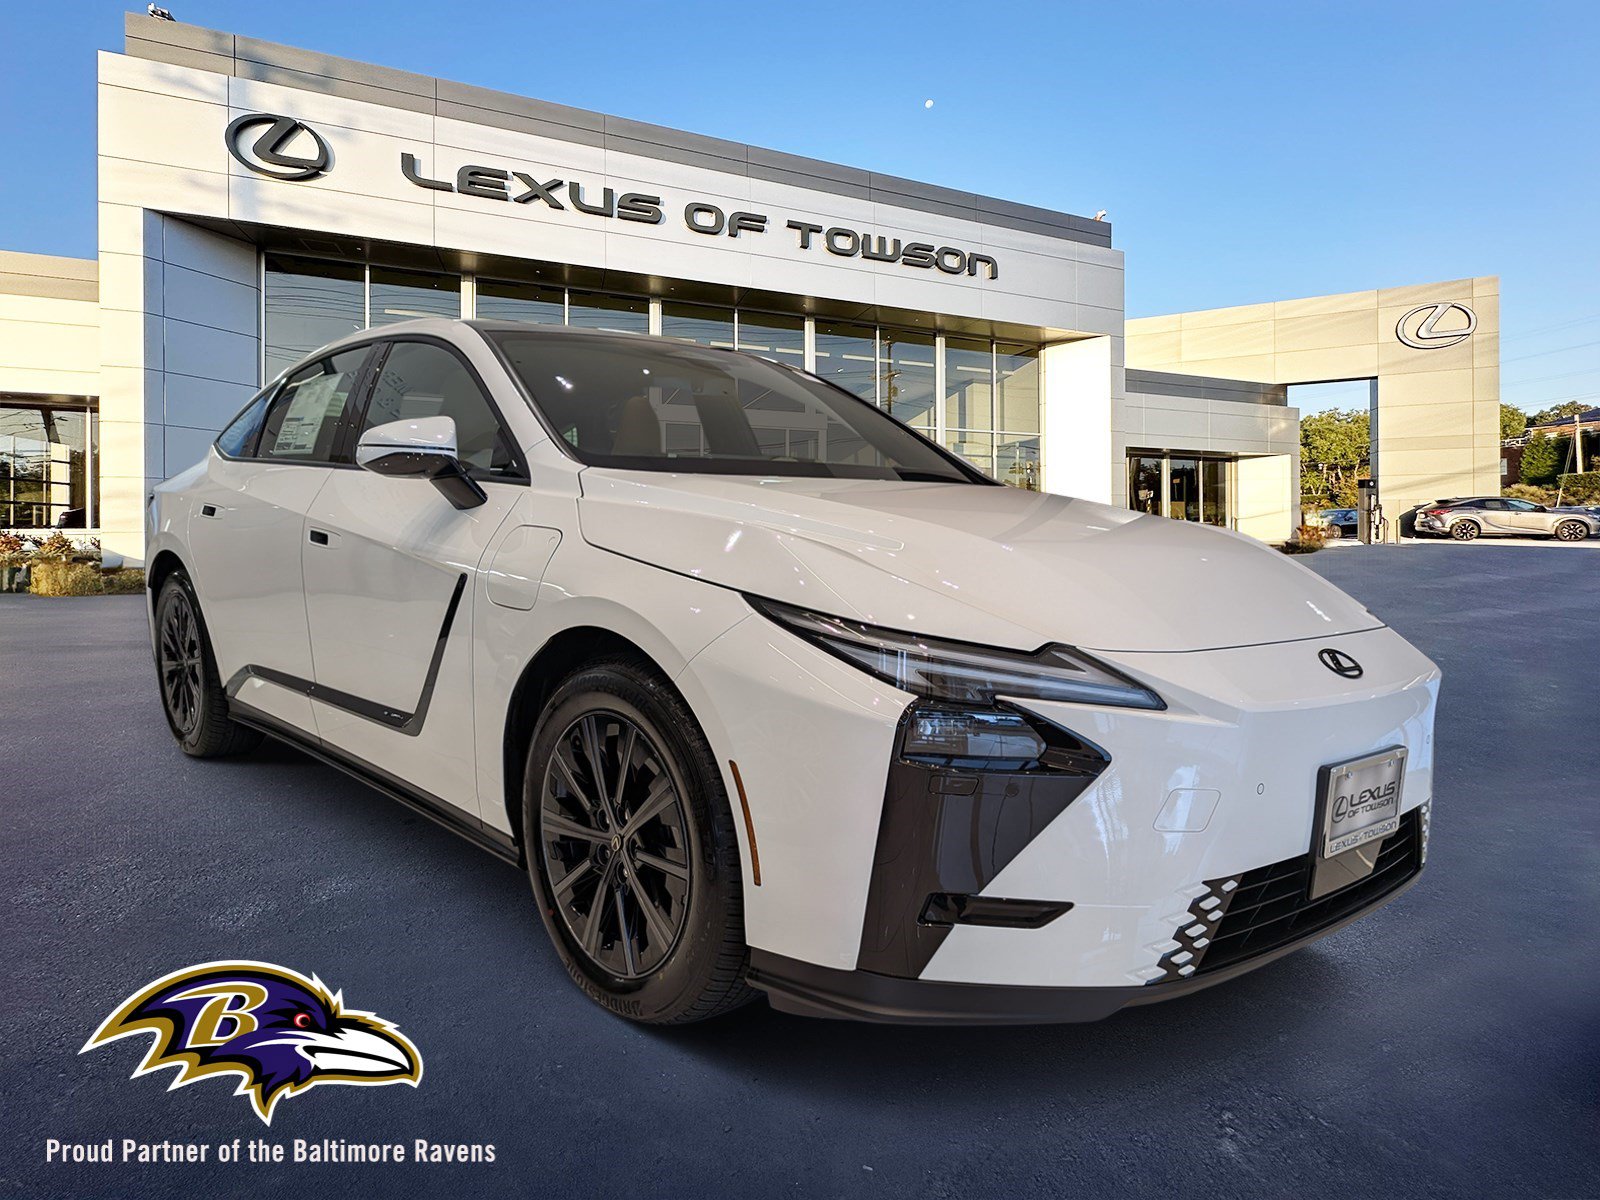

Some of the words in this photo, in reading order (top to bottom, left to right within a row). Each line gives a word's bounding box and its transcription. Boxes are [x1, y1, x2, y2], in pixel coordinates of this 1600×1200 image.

[401, 153, 662, 224] LEXUS
[684, 202, 767, 237] OF
[786, 218, 998, 280] TOWSON
[1348, 808, 1360, 818] OF
[1361, 797, 1393, 813] TOWSON
[1350, 781, 1396, 807] LEXUS
[1330, 836, 1358, 853] LEXUS
[1363, 821, 1396, 839] TOWSON
